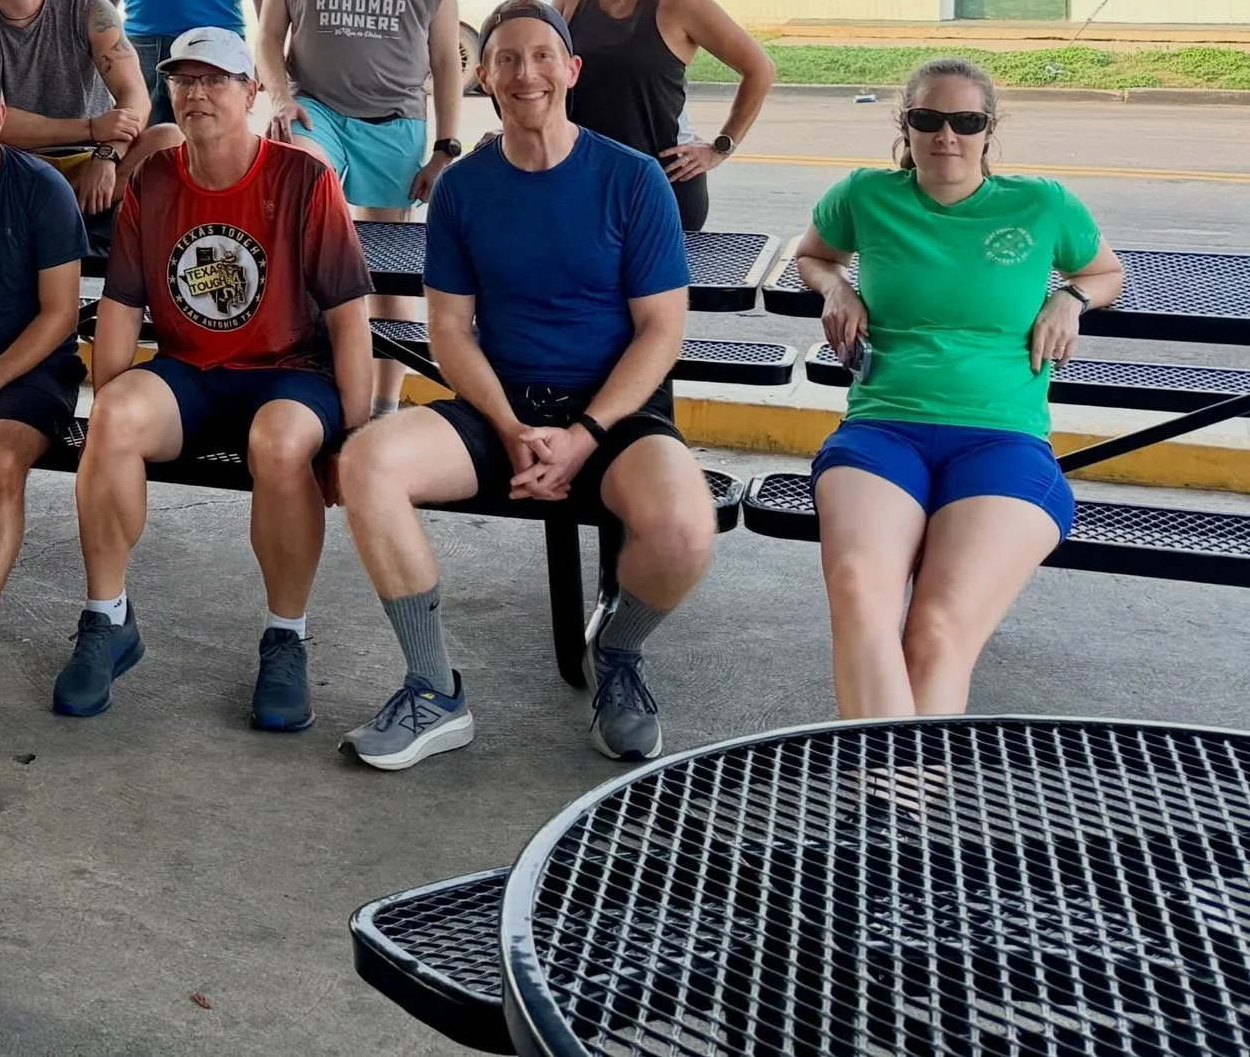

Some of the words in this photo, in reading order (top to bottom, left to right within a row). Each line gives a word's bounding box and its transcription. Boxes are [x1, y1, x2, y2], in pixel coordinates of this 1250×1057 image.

[320, 12, 400, 32] RUNNERS
[176, 226, 214, 250] TEXAS
[222, 226, 260, 255] TOUGH
[191, 277, 228, 292] TOUGH
[182, 306, 198, 320] SAN
[203, 318, 238, 329] ANTONIO
[242, 311, 252, 322] TX
